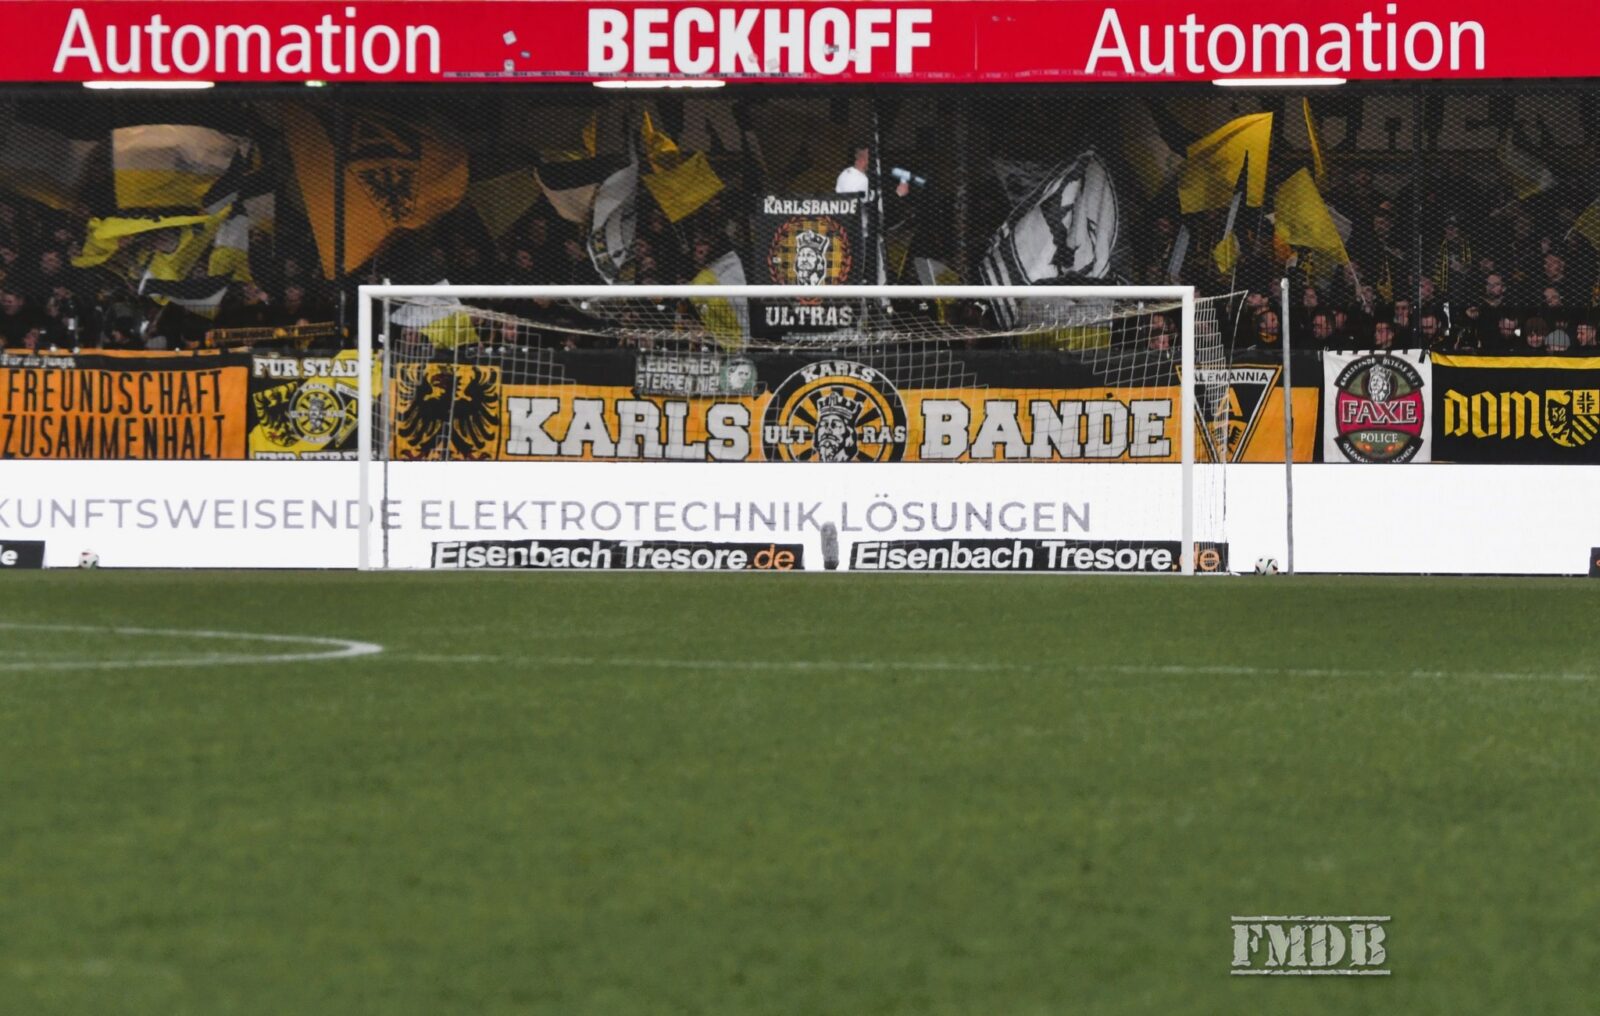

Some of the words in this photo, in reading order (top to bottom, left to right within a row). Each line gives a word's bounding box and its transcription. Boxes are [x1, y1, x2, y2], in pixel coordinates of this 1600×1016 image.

[53, 6, 442, 74] Automation
[587, 7, 933, 76] BECKHOFF
[1084, 3, 1486, 75] Automation
[763, 196, 859, 215] KARLSBANDE
[765, 306, 853, 327] ULTRAS
[302, 358, 374, 378] STAD
[801, 361, 877, 383] KARLS
[7, 369, 222, 415] FREUNDSCHAFT
[506, 396, 752, 460] KARLS
[918, 398, 1173, 460] BANDE
[1341, 399, 1418, 424] FAXE
[2, 413, 225, 459] ZUSAMMENHALT
[1359, 433, 1399, 443] POLICE
[420, 499, 823, 533] ELEKTROTECHNIK
[841, 493, 1091, 533] LÖSUNGEN
[433, 541, 612, 569] Eisenbach
[618, 541, 796, 571] Tresore.de
[854, 541, 1034, 569] Eisenbach
